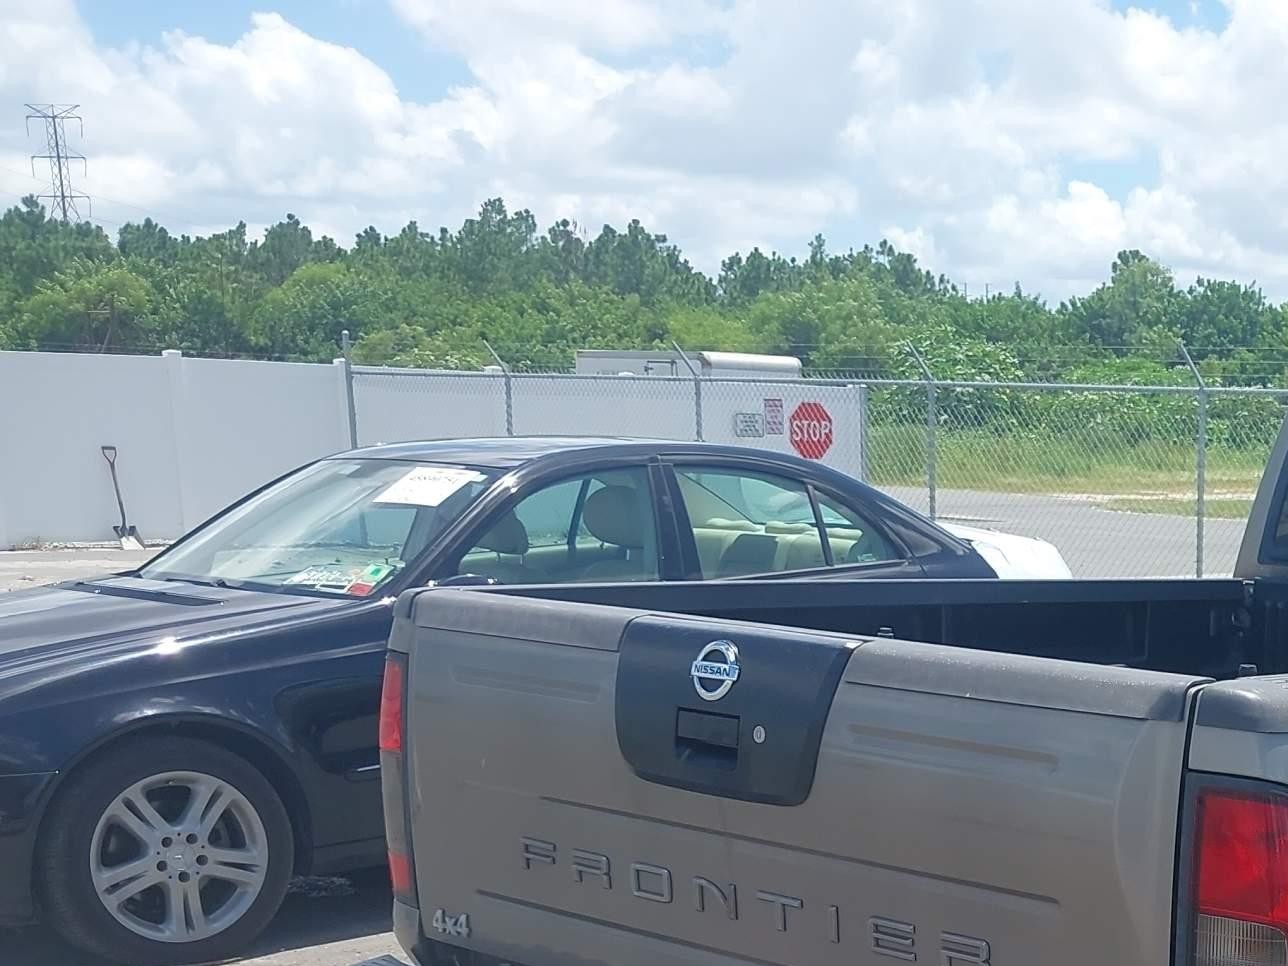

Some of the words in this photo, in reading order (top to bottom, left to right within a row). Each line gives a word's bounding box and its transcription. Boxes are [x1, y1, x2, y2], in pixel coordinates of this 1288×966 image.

[793, 420, 830, 441] STOP
[694, 663, 730, 677] NISSAN
[432, 909, 471, 938] 4x4
